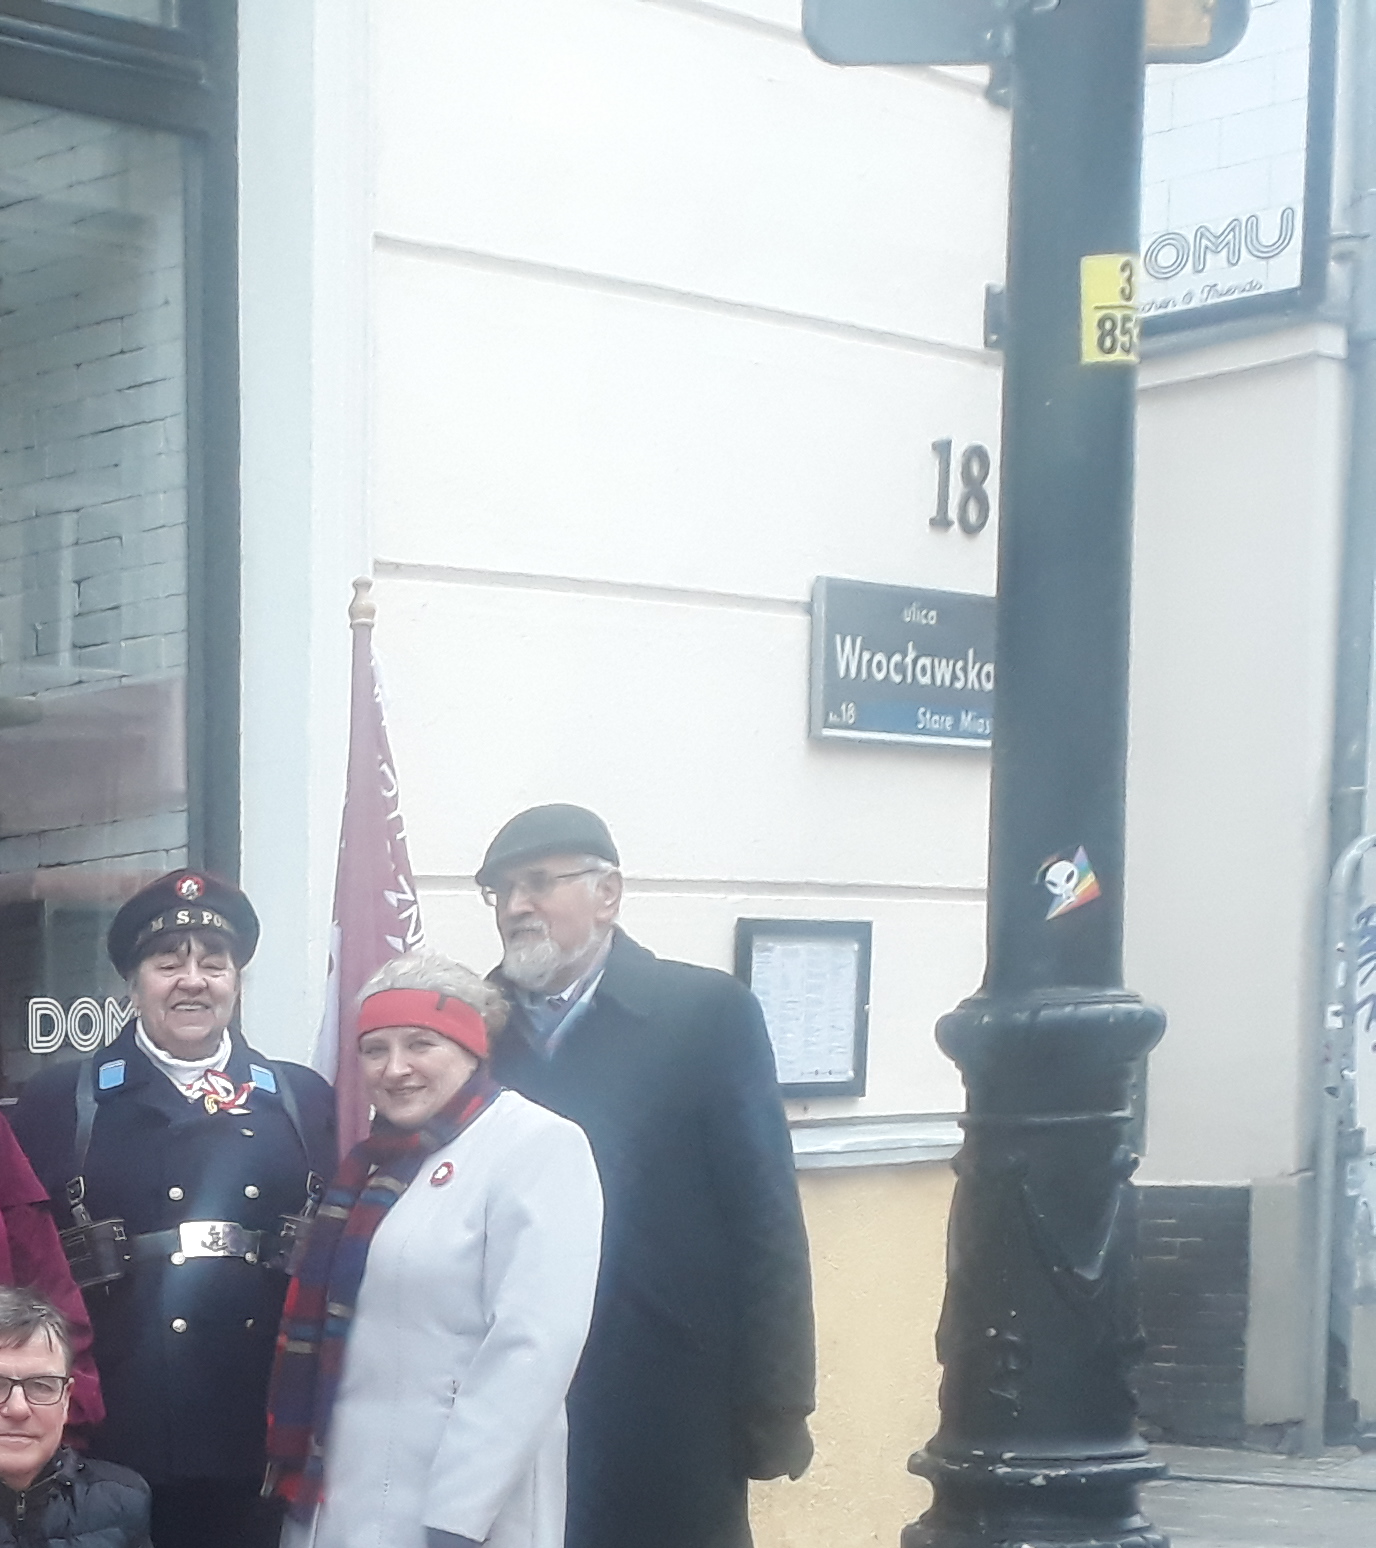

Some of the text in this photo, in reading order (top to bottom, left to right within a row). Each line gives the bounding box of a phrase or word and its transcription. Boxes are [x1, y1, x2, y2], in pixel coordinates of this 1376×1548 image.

[1144, 207, 1295, 280] OMU
[1119, 259, 1133, 302] 3
[928, 438, 991, 535] 18
[903, 602, 938, 626] ulica
[835, 633, 996, 693] Wrocławska
[840, 701, 856, 725] 18
[916, 706, 955, 732] Stare
